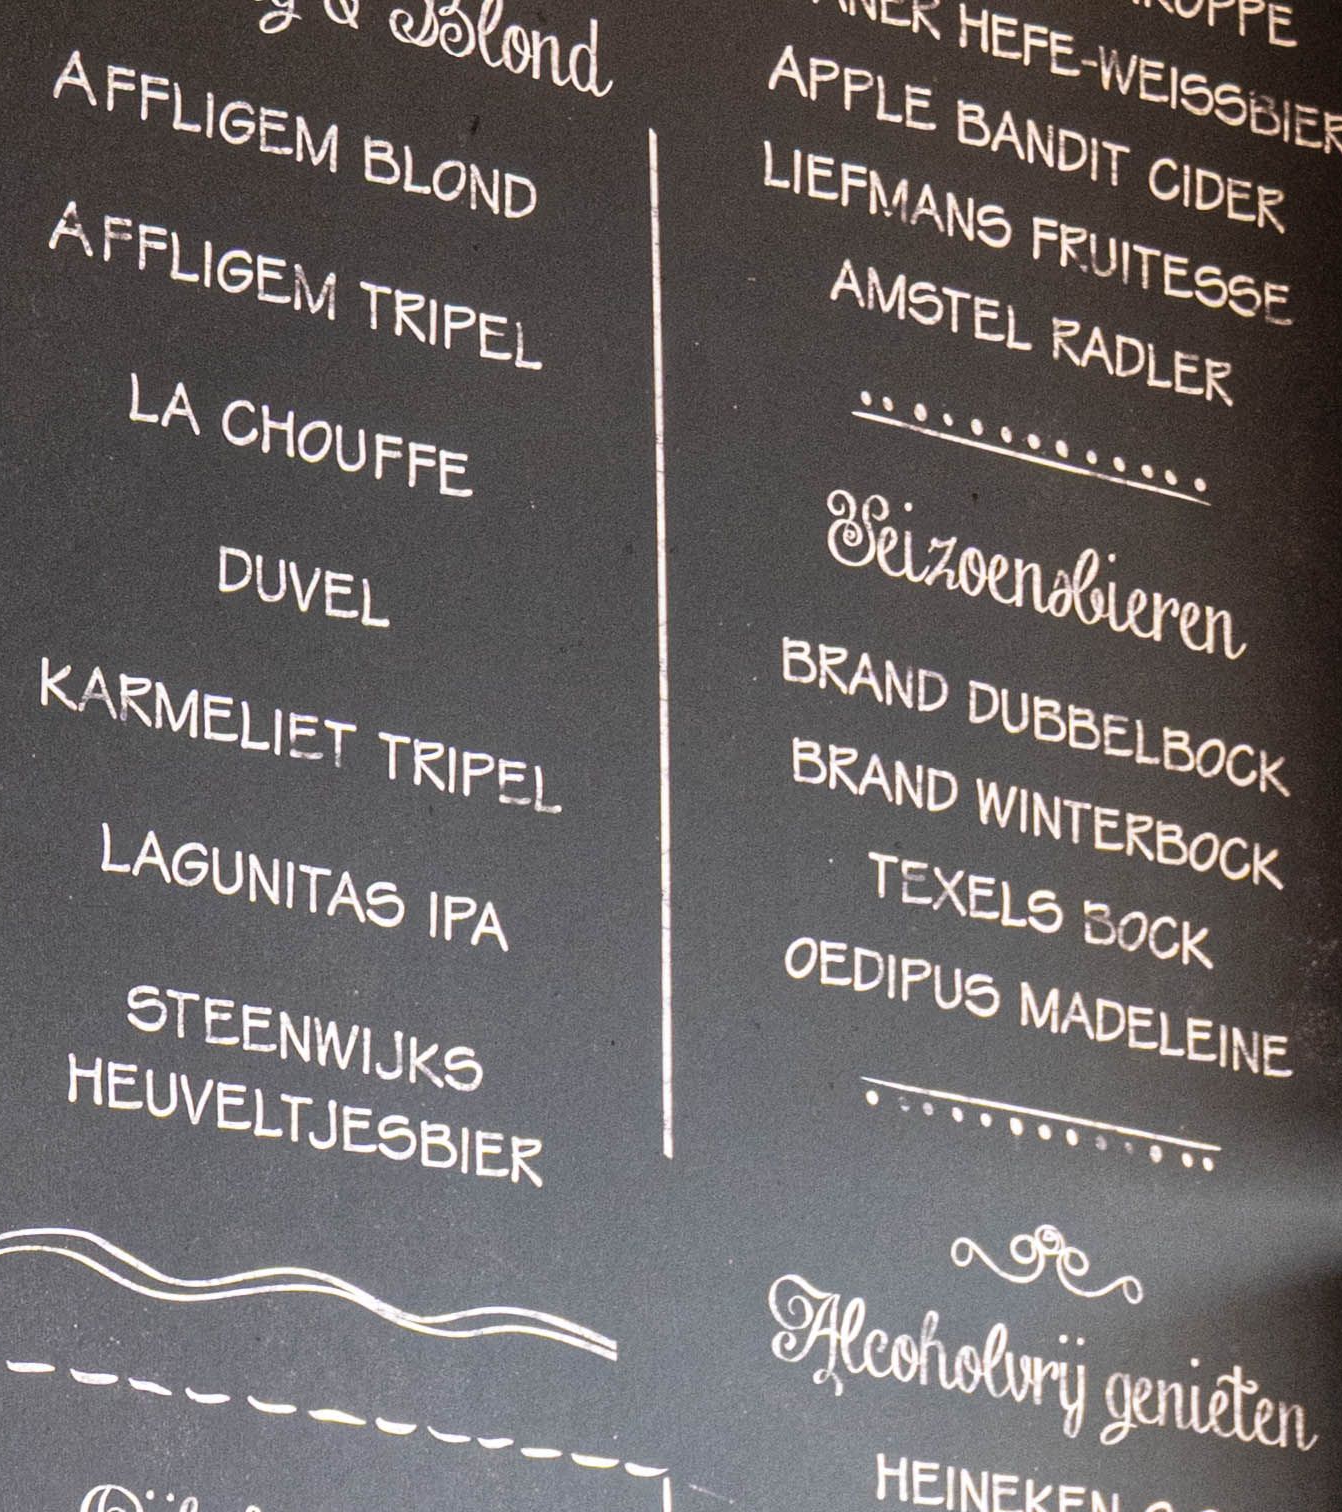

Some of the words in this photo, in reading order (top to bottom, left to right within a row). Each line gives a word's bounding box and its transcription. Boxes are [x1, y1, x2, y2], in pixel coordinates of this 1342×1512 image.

[52, 50, 339, 174] AFFLIGEM
[363, 135, 538, 220] BLOND
[767, 44, 937, 132] APPLE
[957, 99, 1131, 187] BANDIT
[1148, 157, 1286, 235] CIDER
[48, 201, 338, 321] AFFLIGEM
[359, 281, 544, 371] TRIPEL
[763, 139, 1013, 250] LIEFMANS
[1031, 215, 1294, 327] FRUITESSE
[829, 258, 1033, 352] AMSTEL
[1051, 315, 1234, 407] RADLER
[129, 372, 201, 437] LA
[221, 400, 474, 499] CHOUFFE
[217, 545, 391, 628] DUVEL
[825, 488, 1248, 661] Seizoensbieren
[40, 656, 358, 770] KARMELIET
[378, 731, 563, 815] TRIPEL
[781, 636, 950, 714] BRAND
[967, 680, 1292, 799] DUBBELBOCK
[100, 822, 406, 929] LAGUNITAS
[428, 890, 510, 953] IPA
[791, 737, 958, 812] BRAND
[975, 777, 1285, 891] WINTERBOCK
[867, 851, 1064, 934] TEXELS
[1083, 900, 1214, 971] BOCK
[126, 984, 484, 1092] STEENWIJKS
[784, 936, 1001, 1019] OEDIPUS
[1019, 982, 1294, 1079] MADELEINE
[67, 1052, 544, 1188] HEUVELTJESBIER
[767, 1273, 1089, 1439] Alcoholvrij
[1099, 1357, 1319, 1452] genieten
